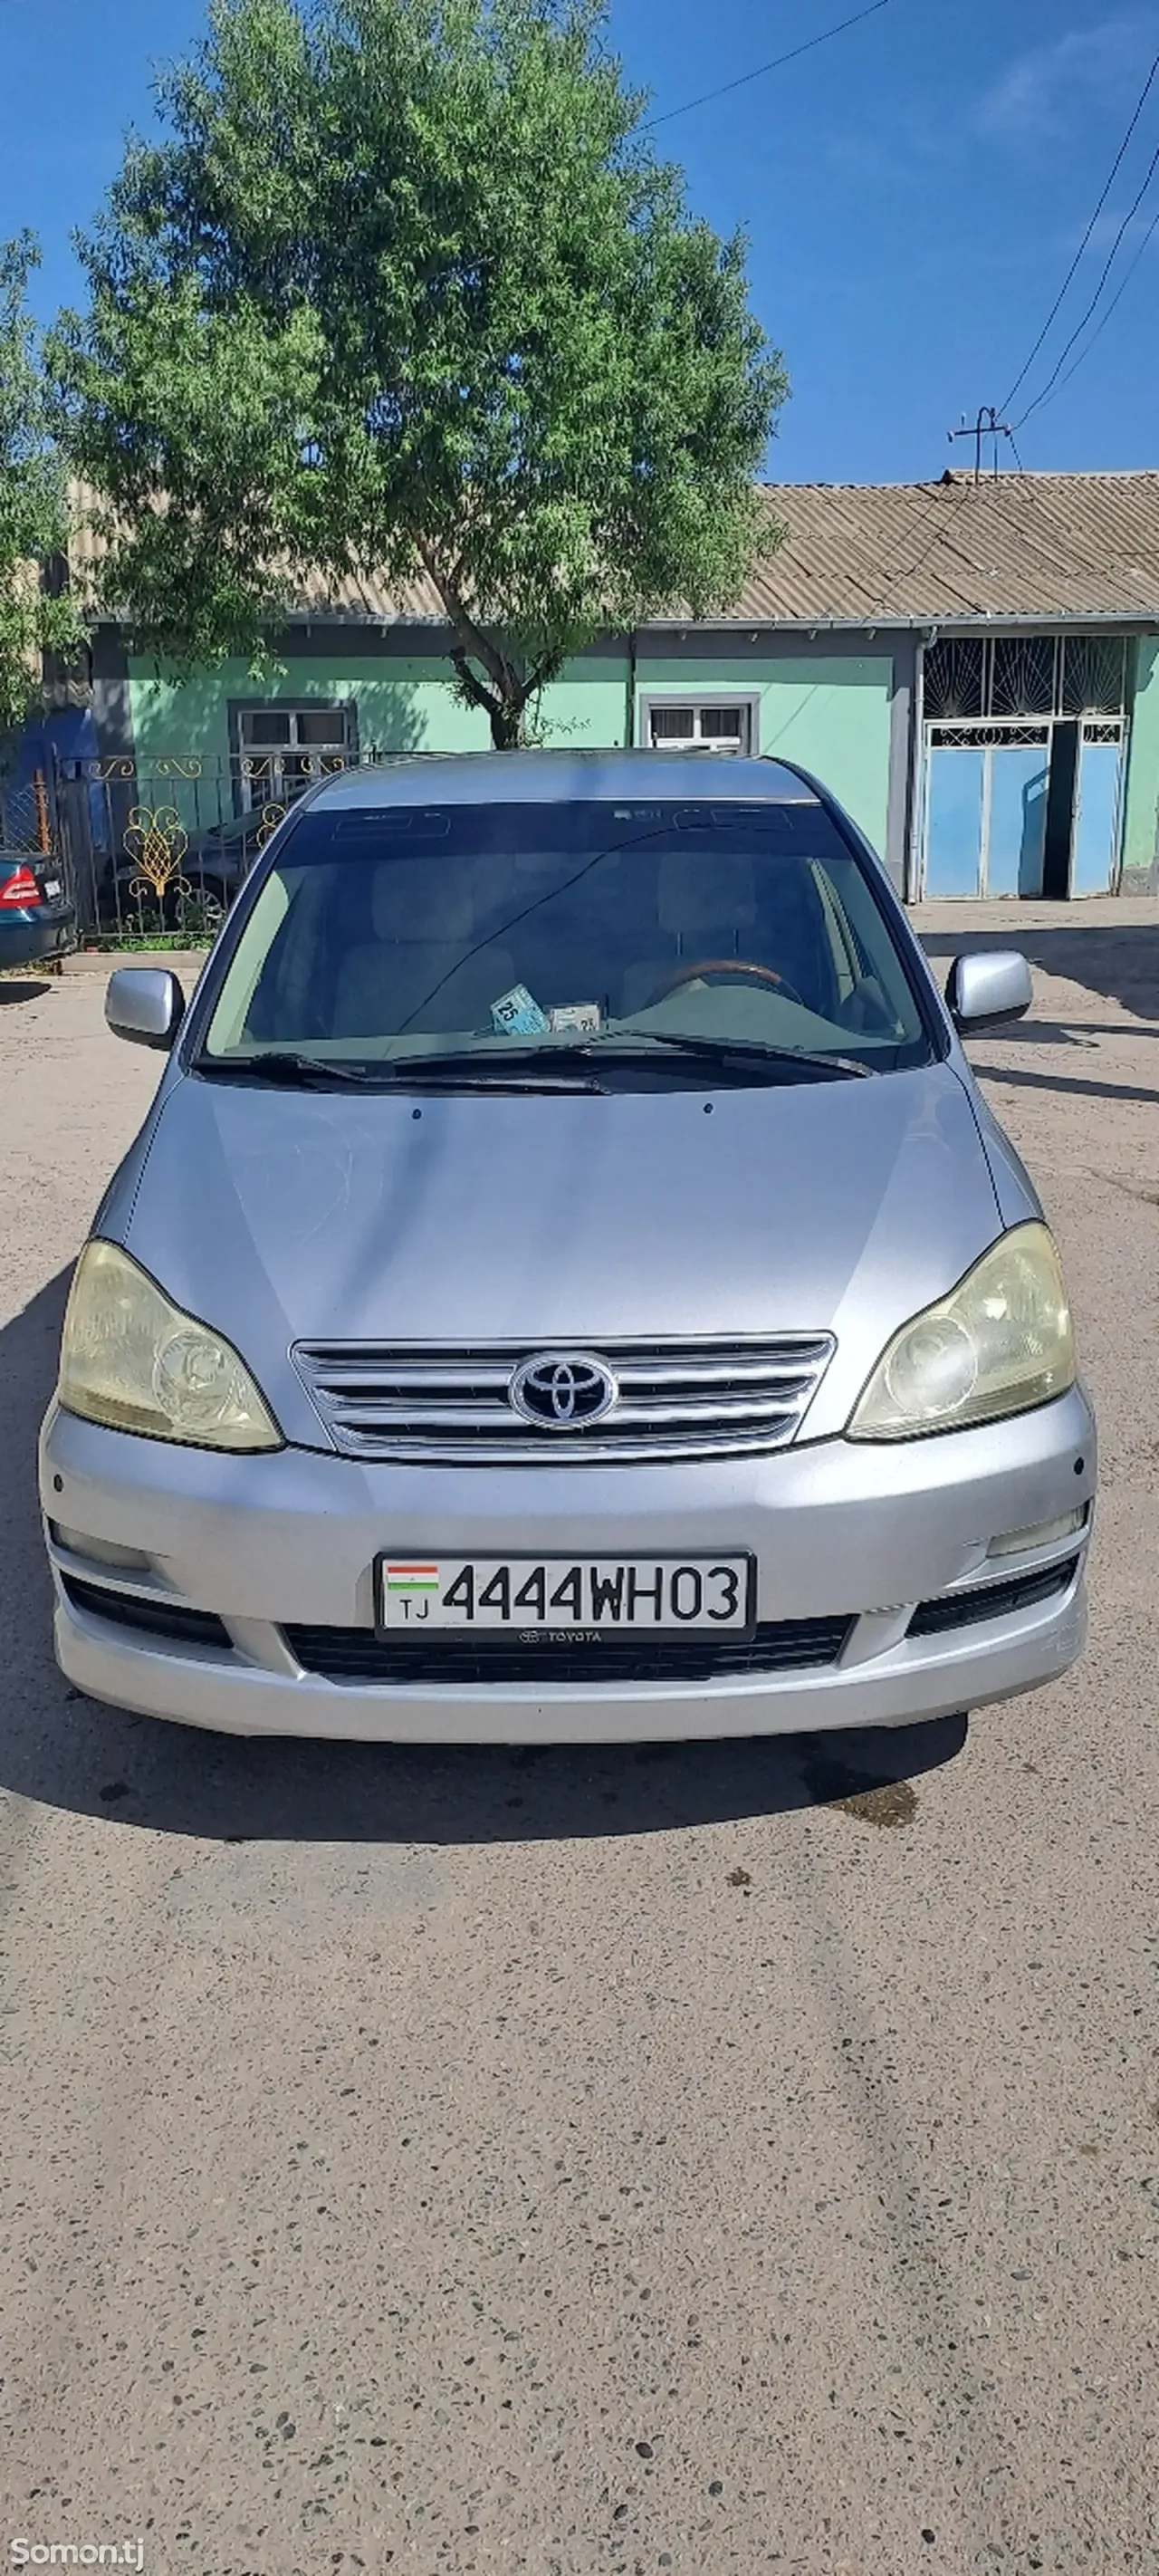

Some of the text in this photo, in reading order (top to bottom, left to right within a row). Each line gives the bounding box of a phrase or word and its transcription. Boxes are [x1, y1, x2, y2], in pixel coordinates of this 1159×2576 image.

[498, 1001, 519, 1022] 25
[399, 1565, 739, 1620] TJ 4444WH03
[548, 1631, 602, 1642] TOYOTA
